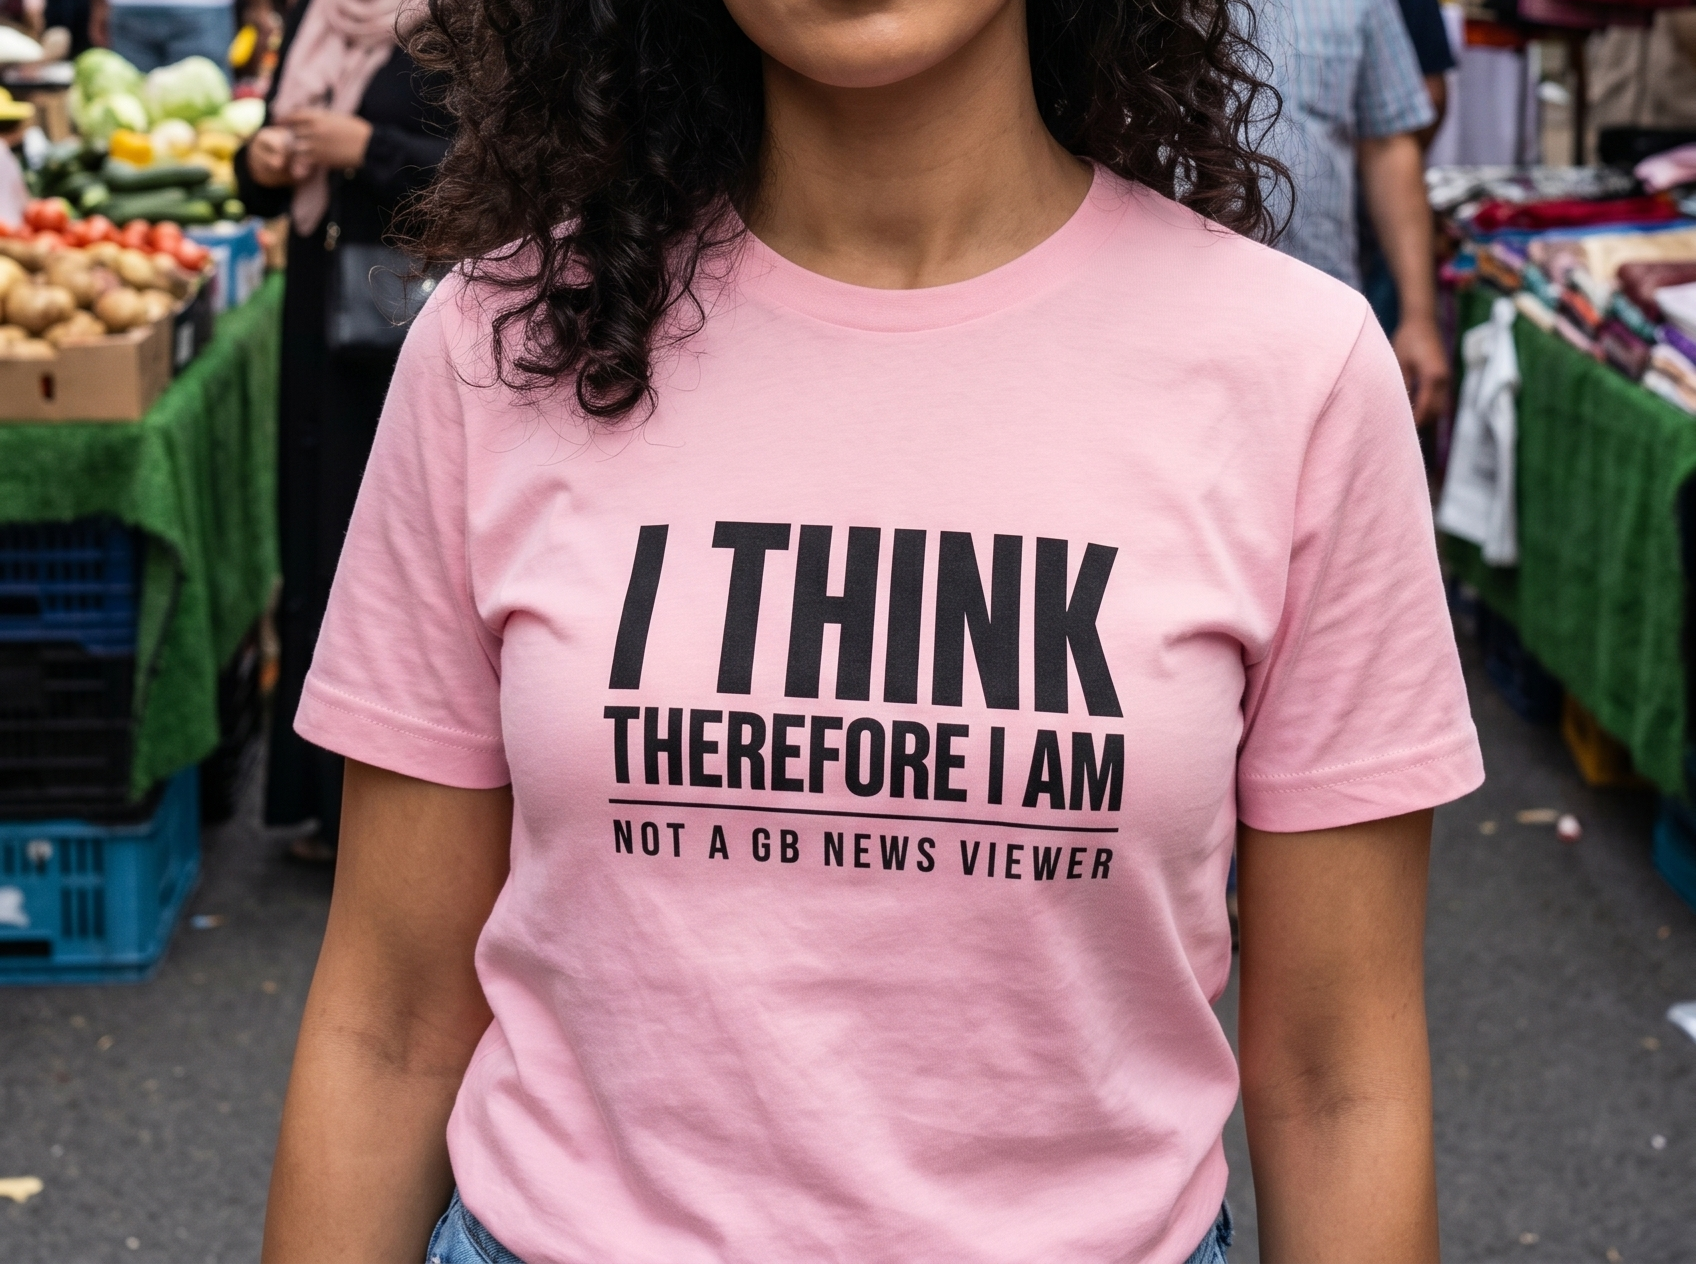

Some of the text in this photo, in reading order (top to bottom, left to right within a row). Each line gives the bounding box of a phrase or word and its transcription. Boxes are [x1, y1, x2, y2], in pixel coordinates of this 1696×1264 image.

[609, 521, 1123, 717] I THINK
[604, 706, 1124, 811] THEREFORE I AM
[613, 819, 1113, 881] NOT A GB NEWS VIEWER
